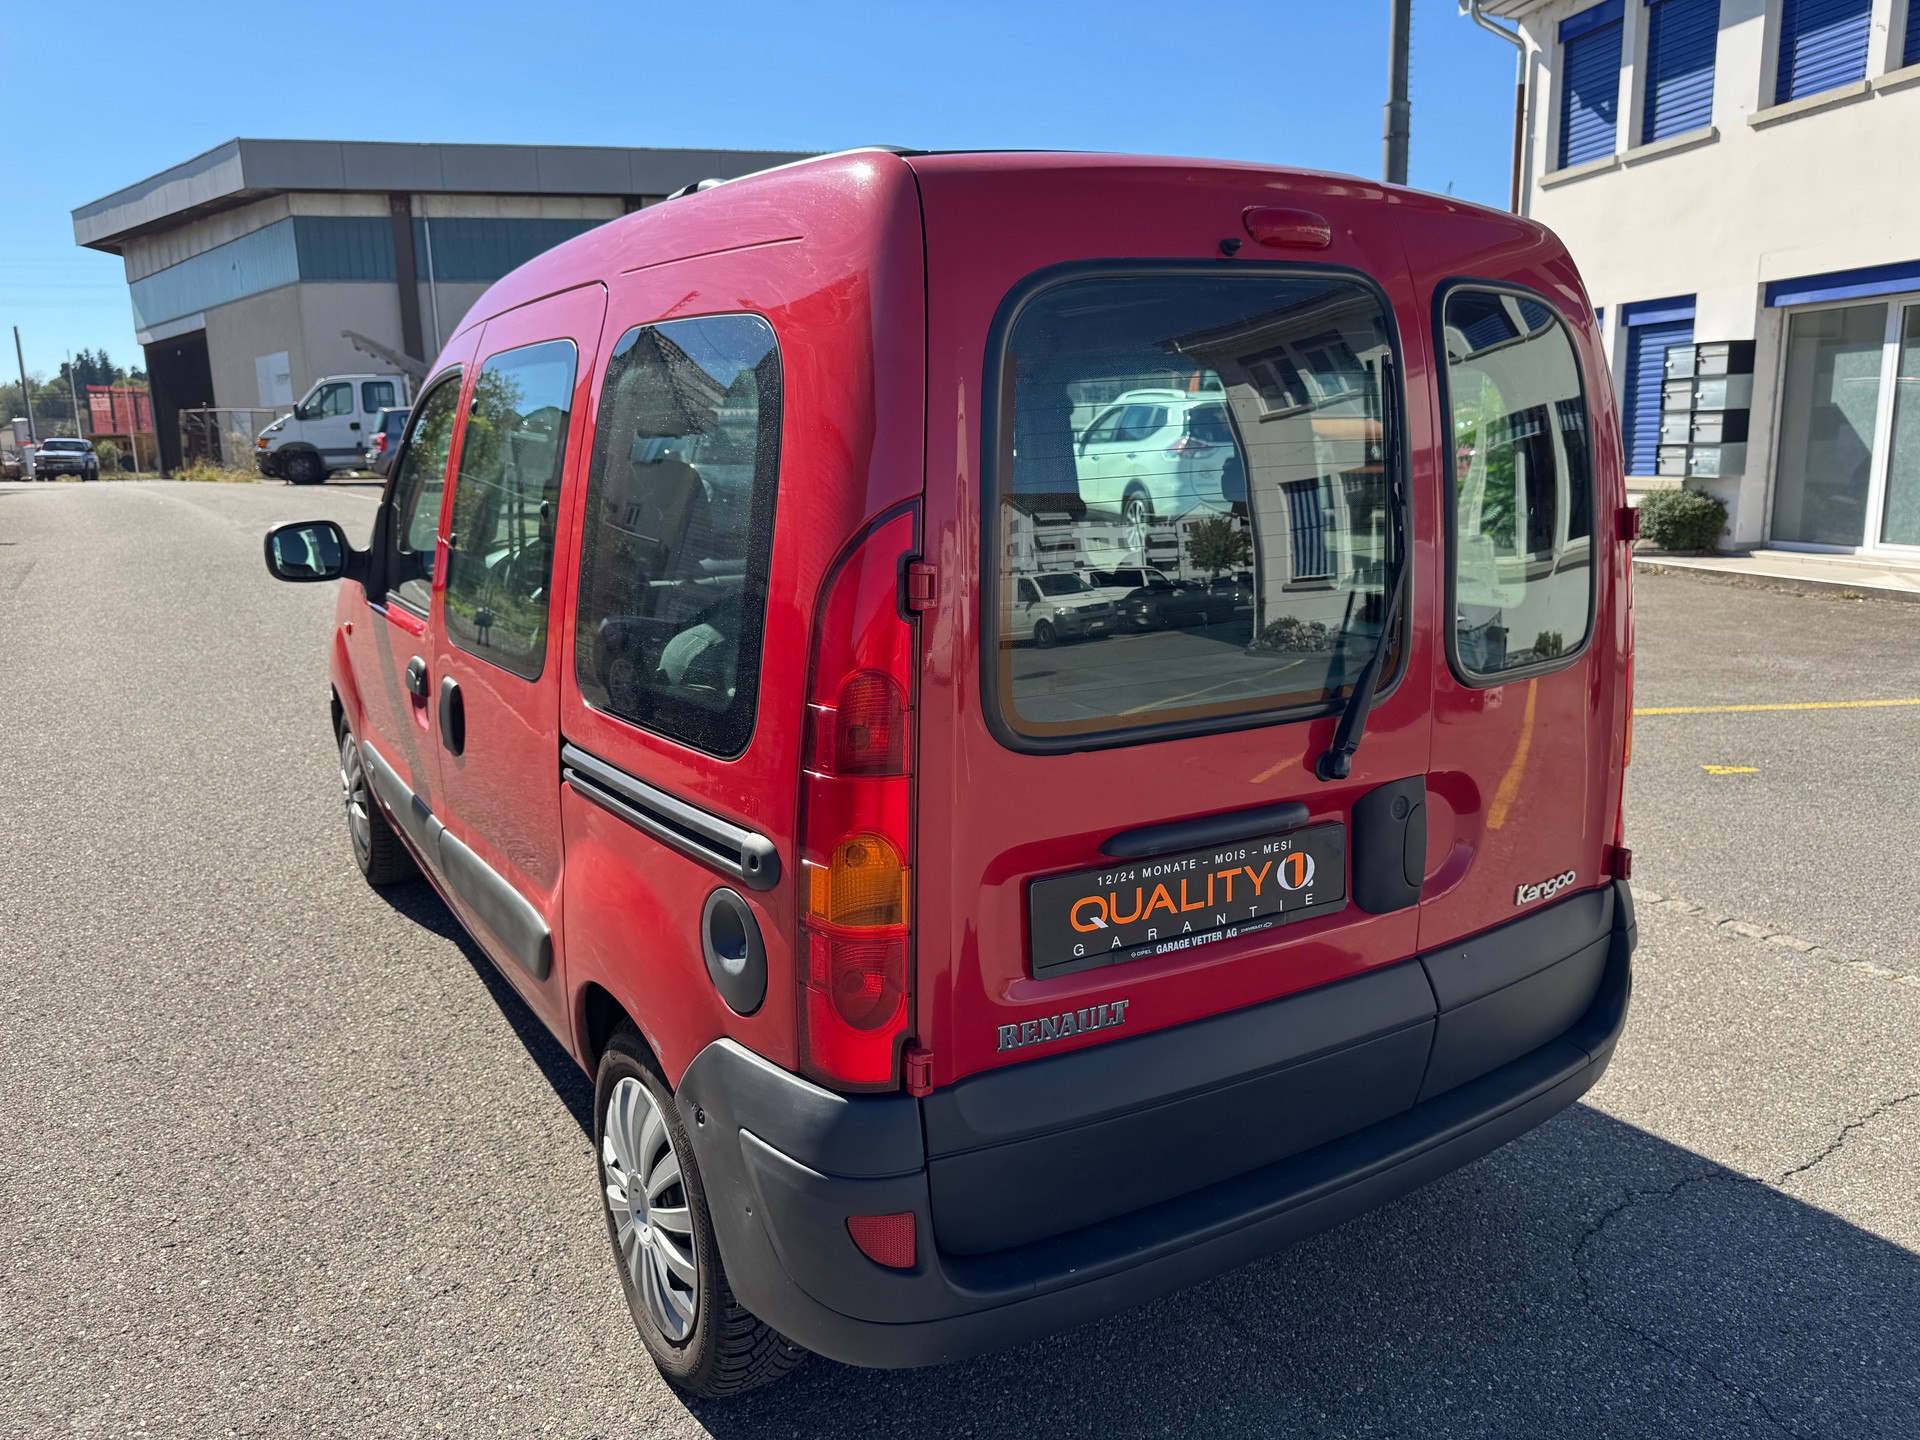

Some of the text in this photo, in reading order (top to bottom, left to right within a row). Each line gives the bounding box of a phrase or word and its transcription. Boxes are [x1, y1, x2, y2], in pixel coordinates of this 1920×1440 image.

[1097, 870, 1135, 886] 12/24
[1142, 859, 1197, 878] MONATE
[1215, 849, 1246, 864] MOIS
[1263, 839, 1292, 854] MESI
[1515, 869, 1576, 906] Kangoo
[1070, 860, 1273, 933] QUALITY
[1073, 893, 1314, 957] GARANTIE
[1156, 937, 1190, 955] GARAGE
[1191, 931, 1223, 946] VETTER
[1226, 927, 1238, 939] AG
[996, 999, 1129, 1052] RENAULT
